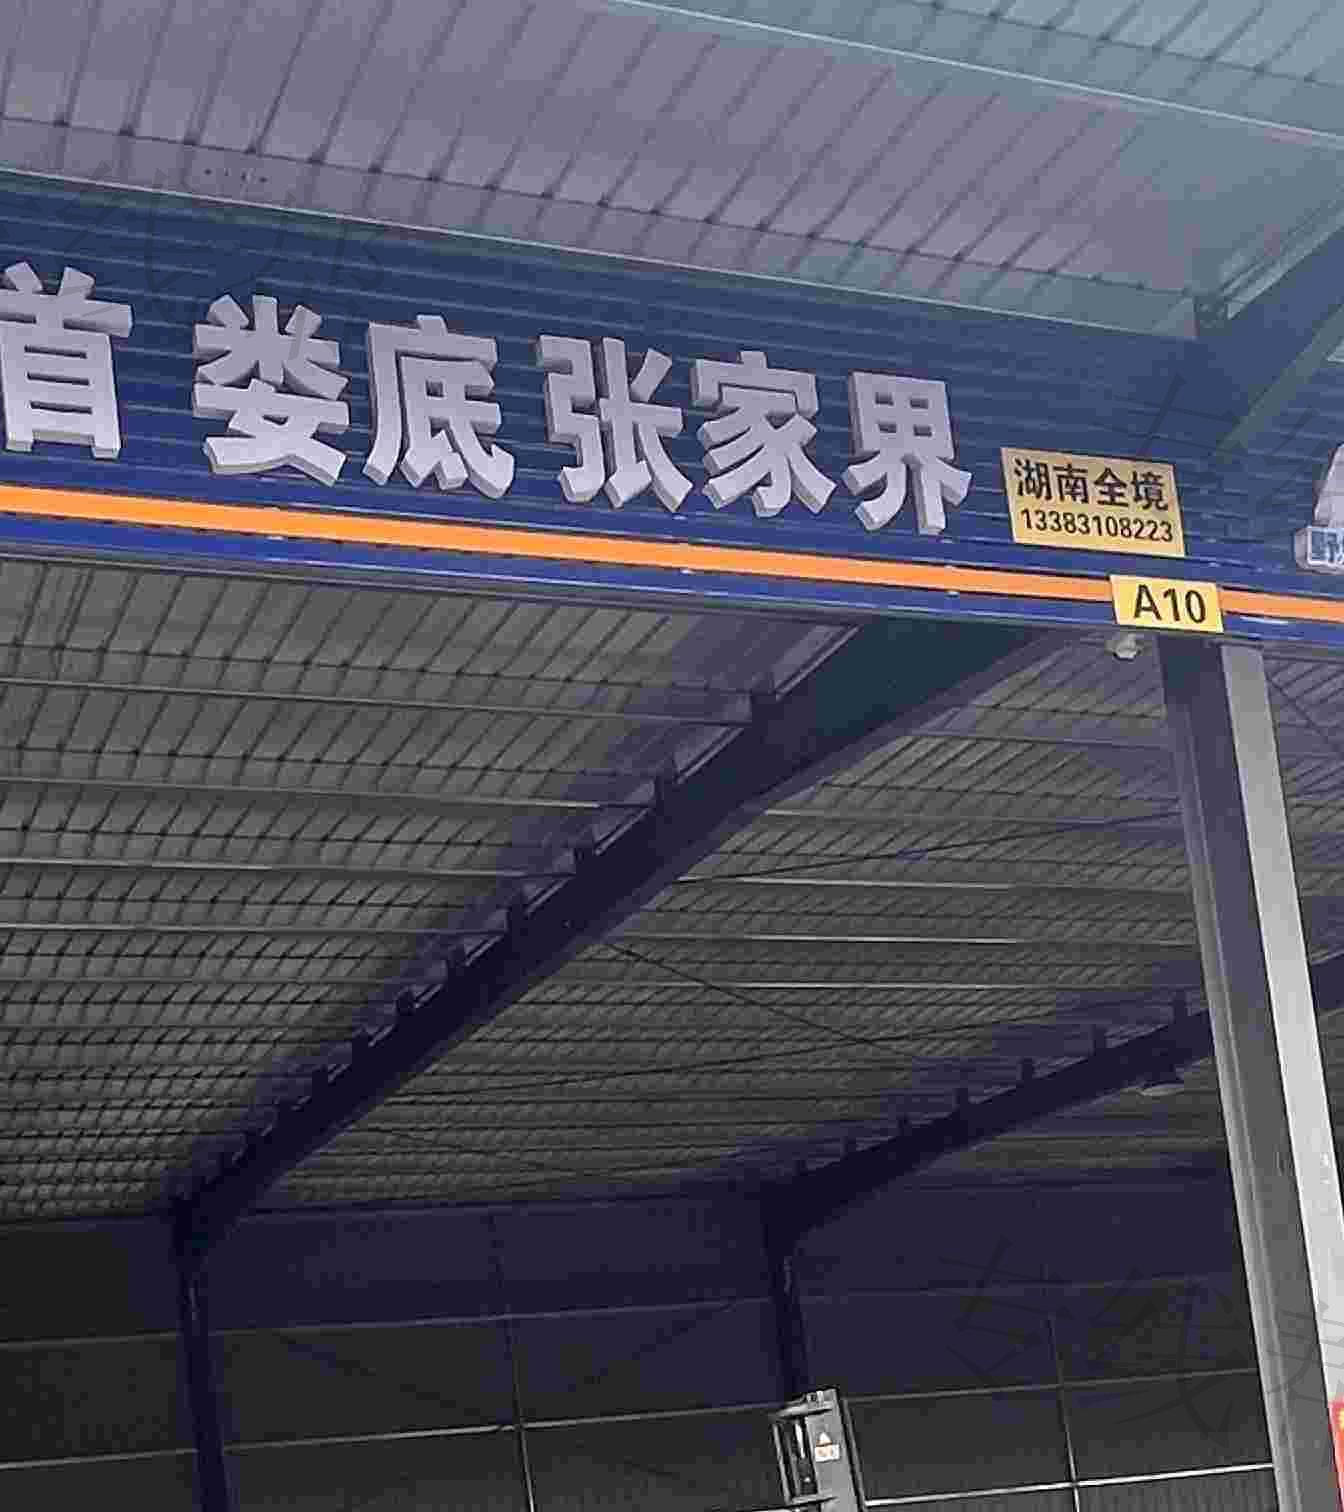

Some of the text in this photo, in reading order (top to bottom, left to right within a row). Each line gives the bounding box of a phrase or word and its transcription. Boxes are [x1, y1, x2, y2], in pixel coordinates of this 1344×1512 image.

[192, 294, 516, 500] 娄底
[536, 335, 972, 536] 张家界
[1013, 456, 1170, 512] 湖南全境
[1019, 508, 1174, 542] 13383108223
[1131, 583, 1207, 625] A10
